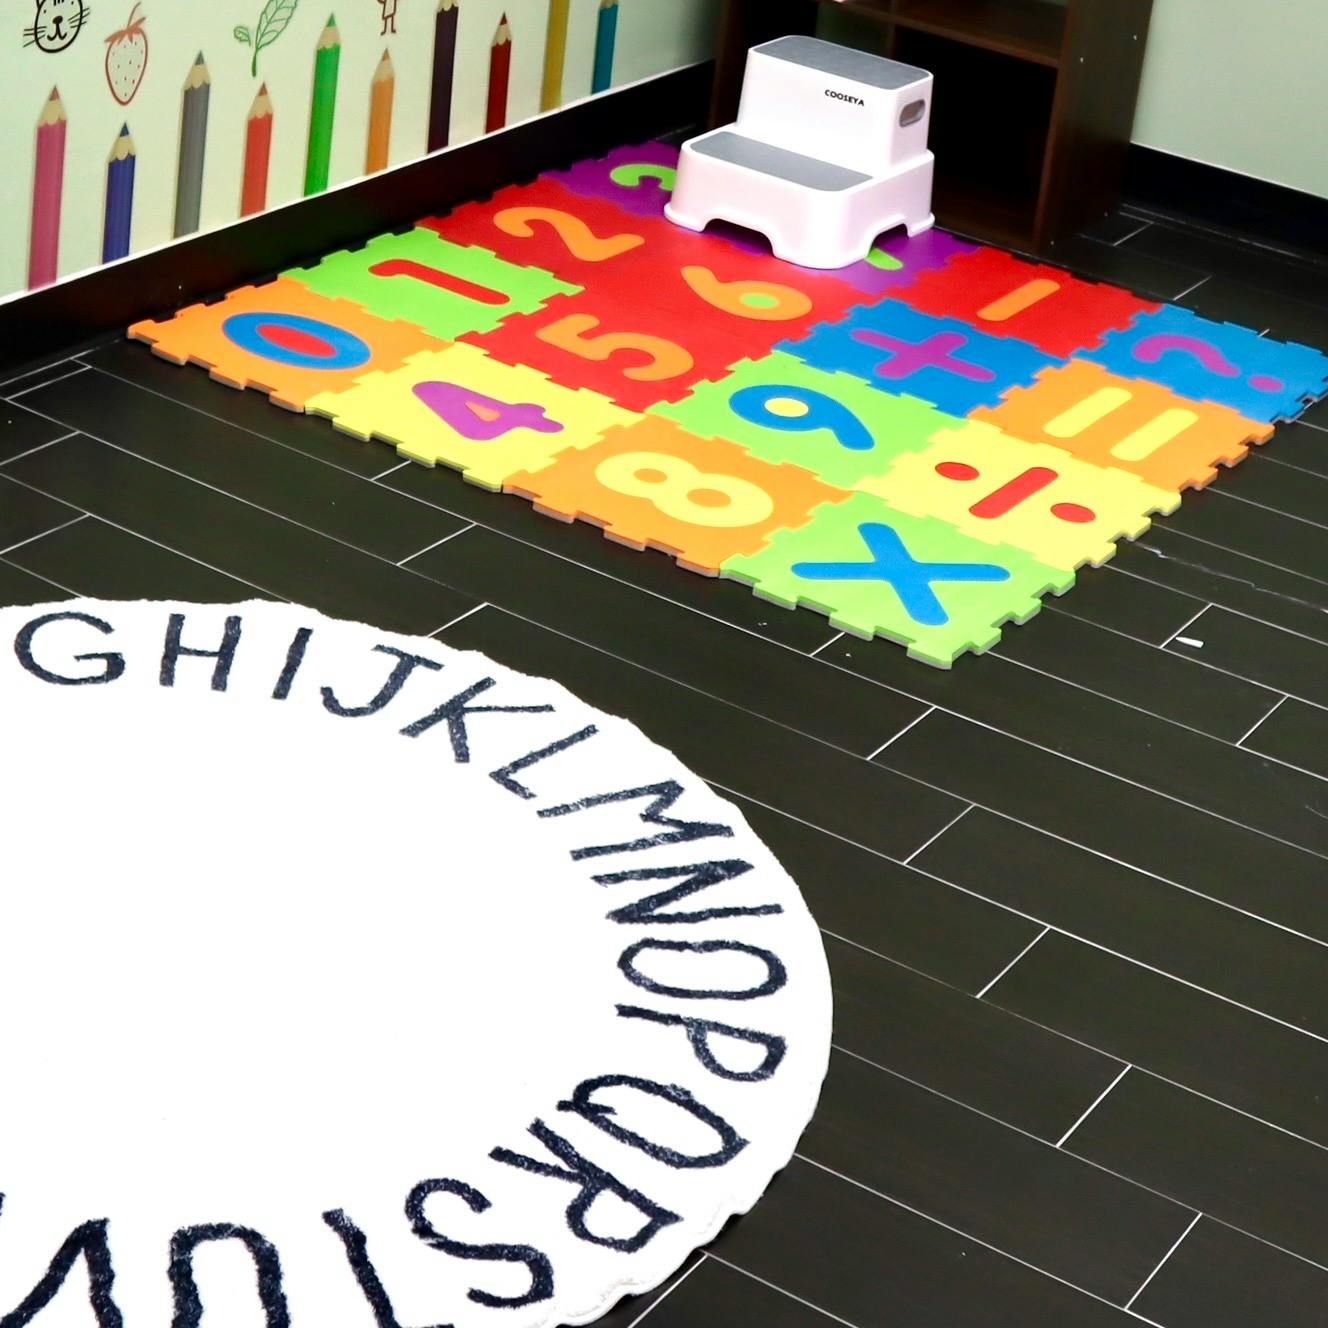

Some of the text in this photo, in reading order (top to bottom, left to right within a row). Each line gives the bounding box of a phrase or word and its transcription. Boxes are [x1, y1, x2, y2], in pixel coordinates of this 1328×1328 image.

[493, 206, 645, 262] 2
[368, 259, 510, 305] 1
[680, 266, 812, 322] 6
[222, 312, 371, 369] 0
[535, 313, 694, 381] 5
[411, 380, 564, 441] 4
[729, 384, 875, 450] 9
[595, 451, 773, 527] 8
